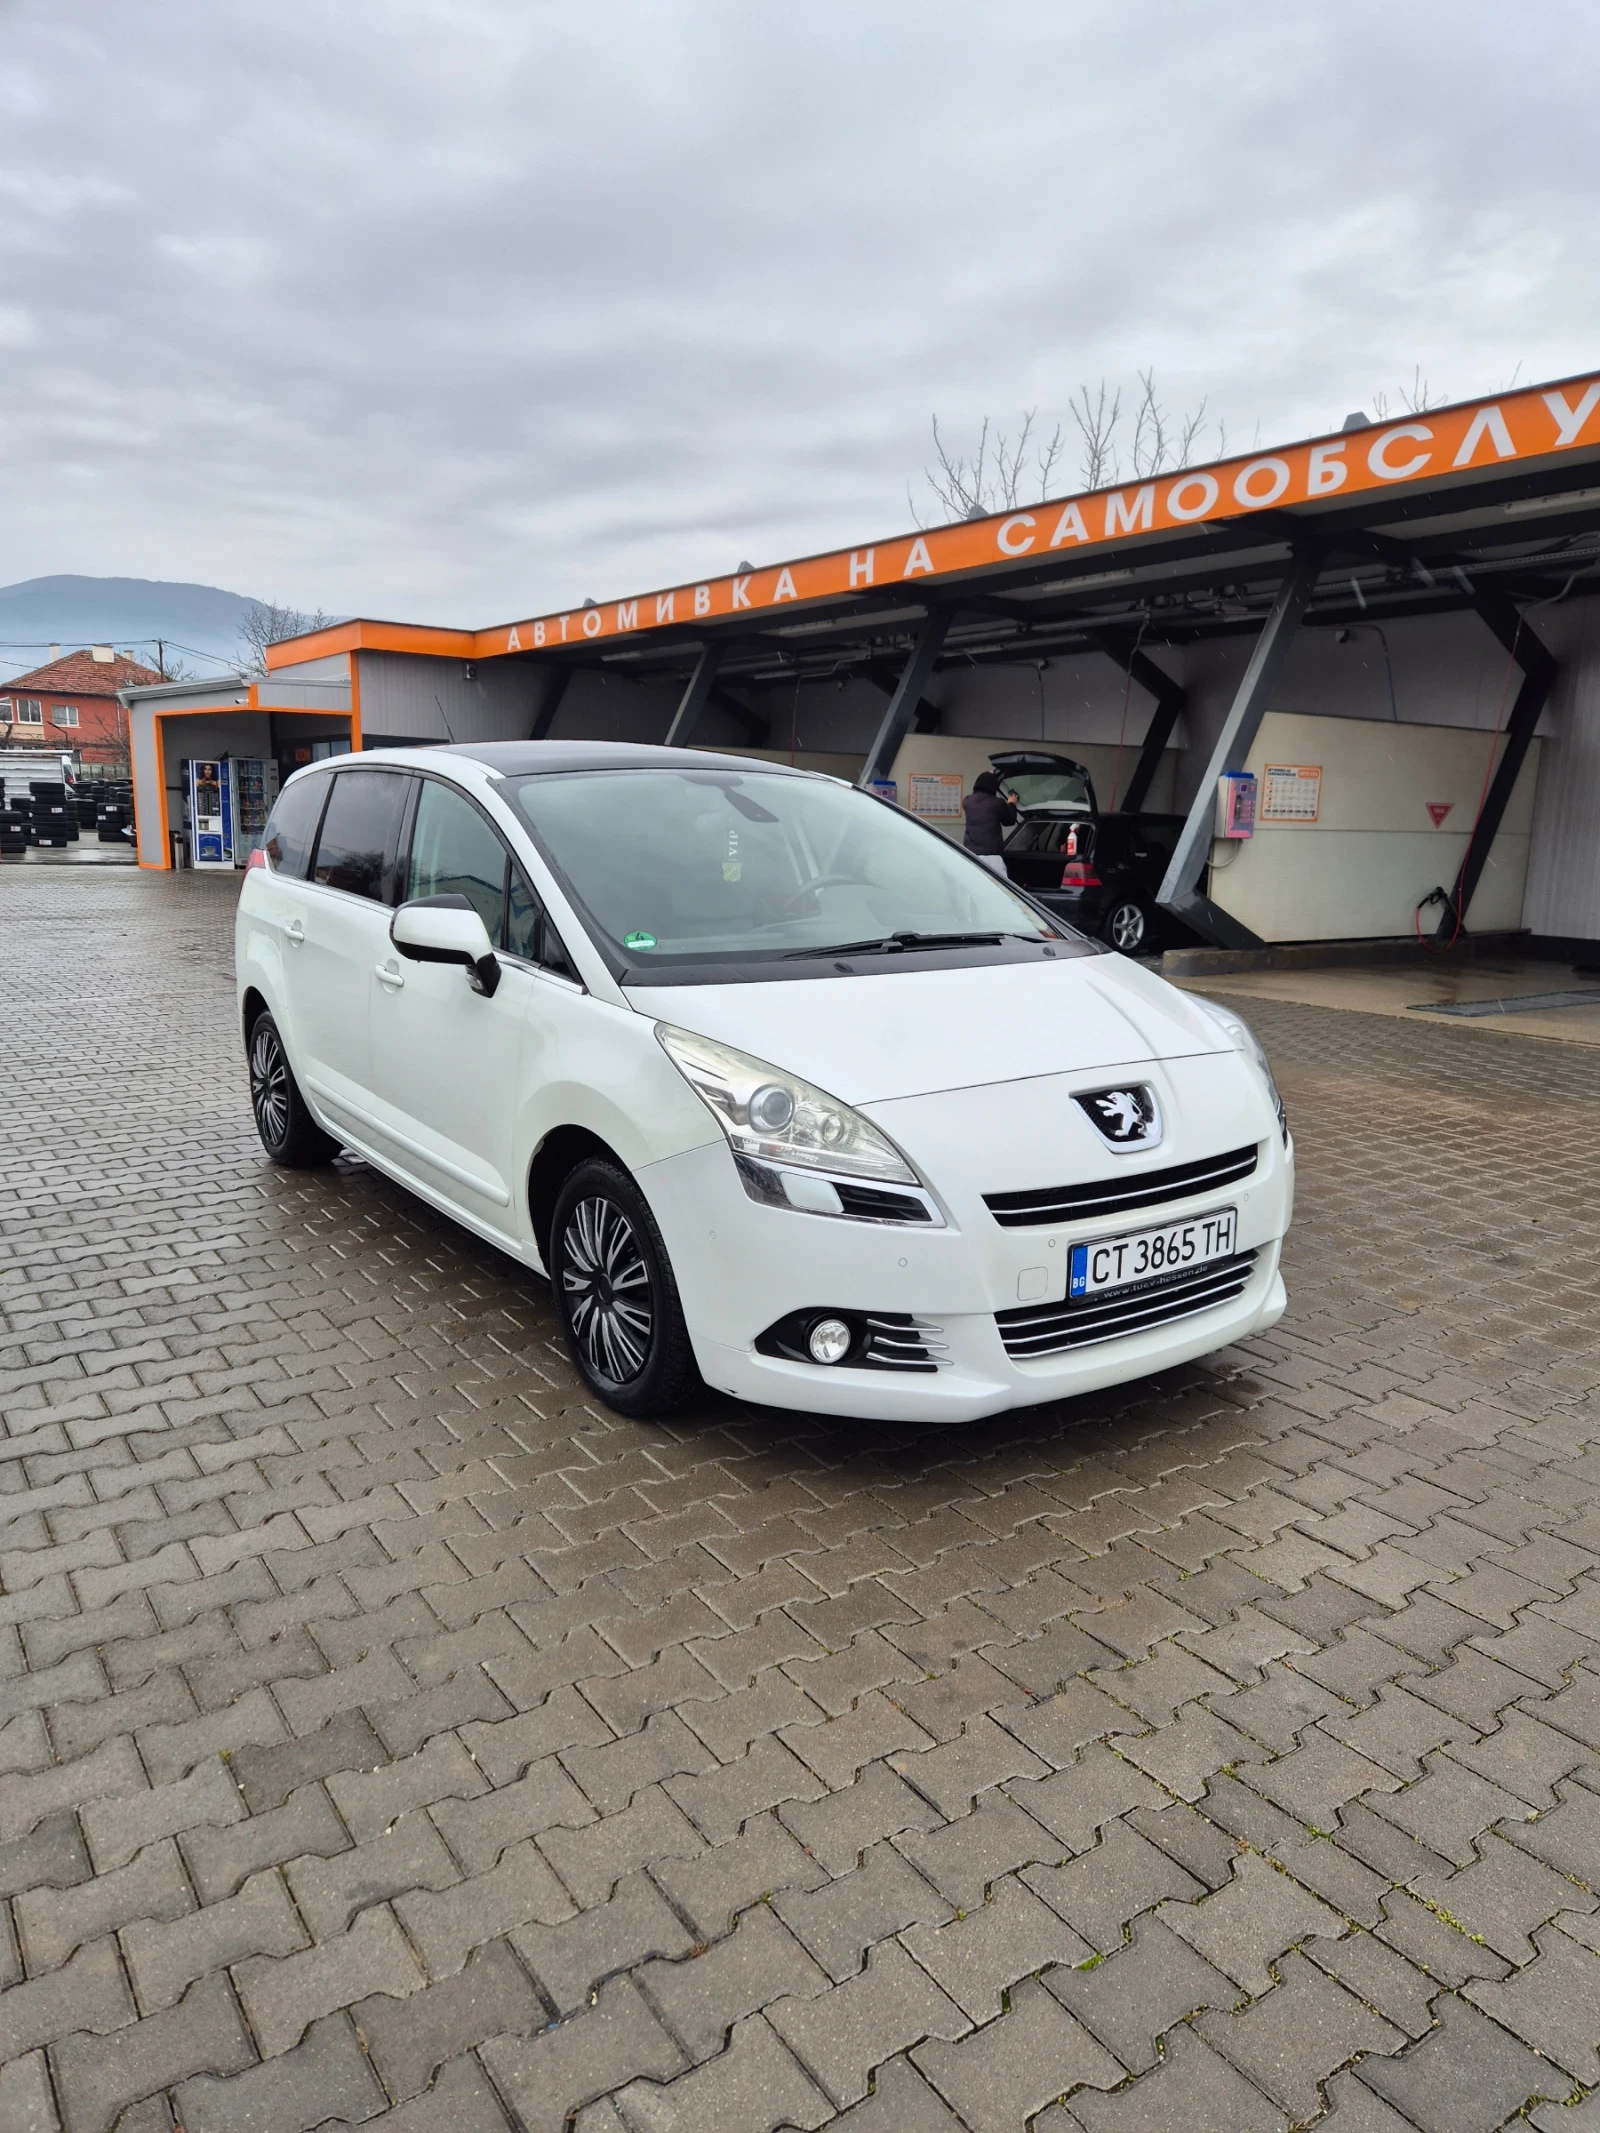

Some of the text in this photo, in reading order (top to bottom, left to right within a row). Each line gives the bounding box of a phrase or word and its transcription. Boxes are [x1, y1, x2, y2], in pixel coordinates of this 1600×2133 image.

[507, 567, 798, 651] АВТОМИВКА
[849, 538, 935, 588] НА
[1092, 1217, 1231, 1284] CT 3865 TH
[1072, 1276, 1086, 1289] BG
[1103, 1264, 1209, 1299] www.tuev-hessen.de
